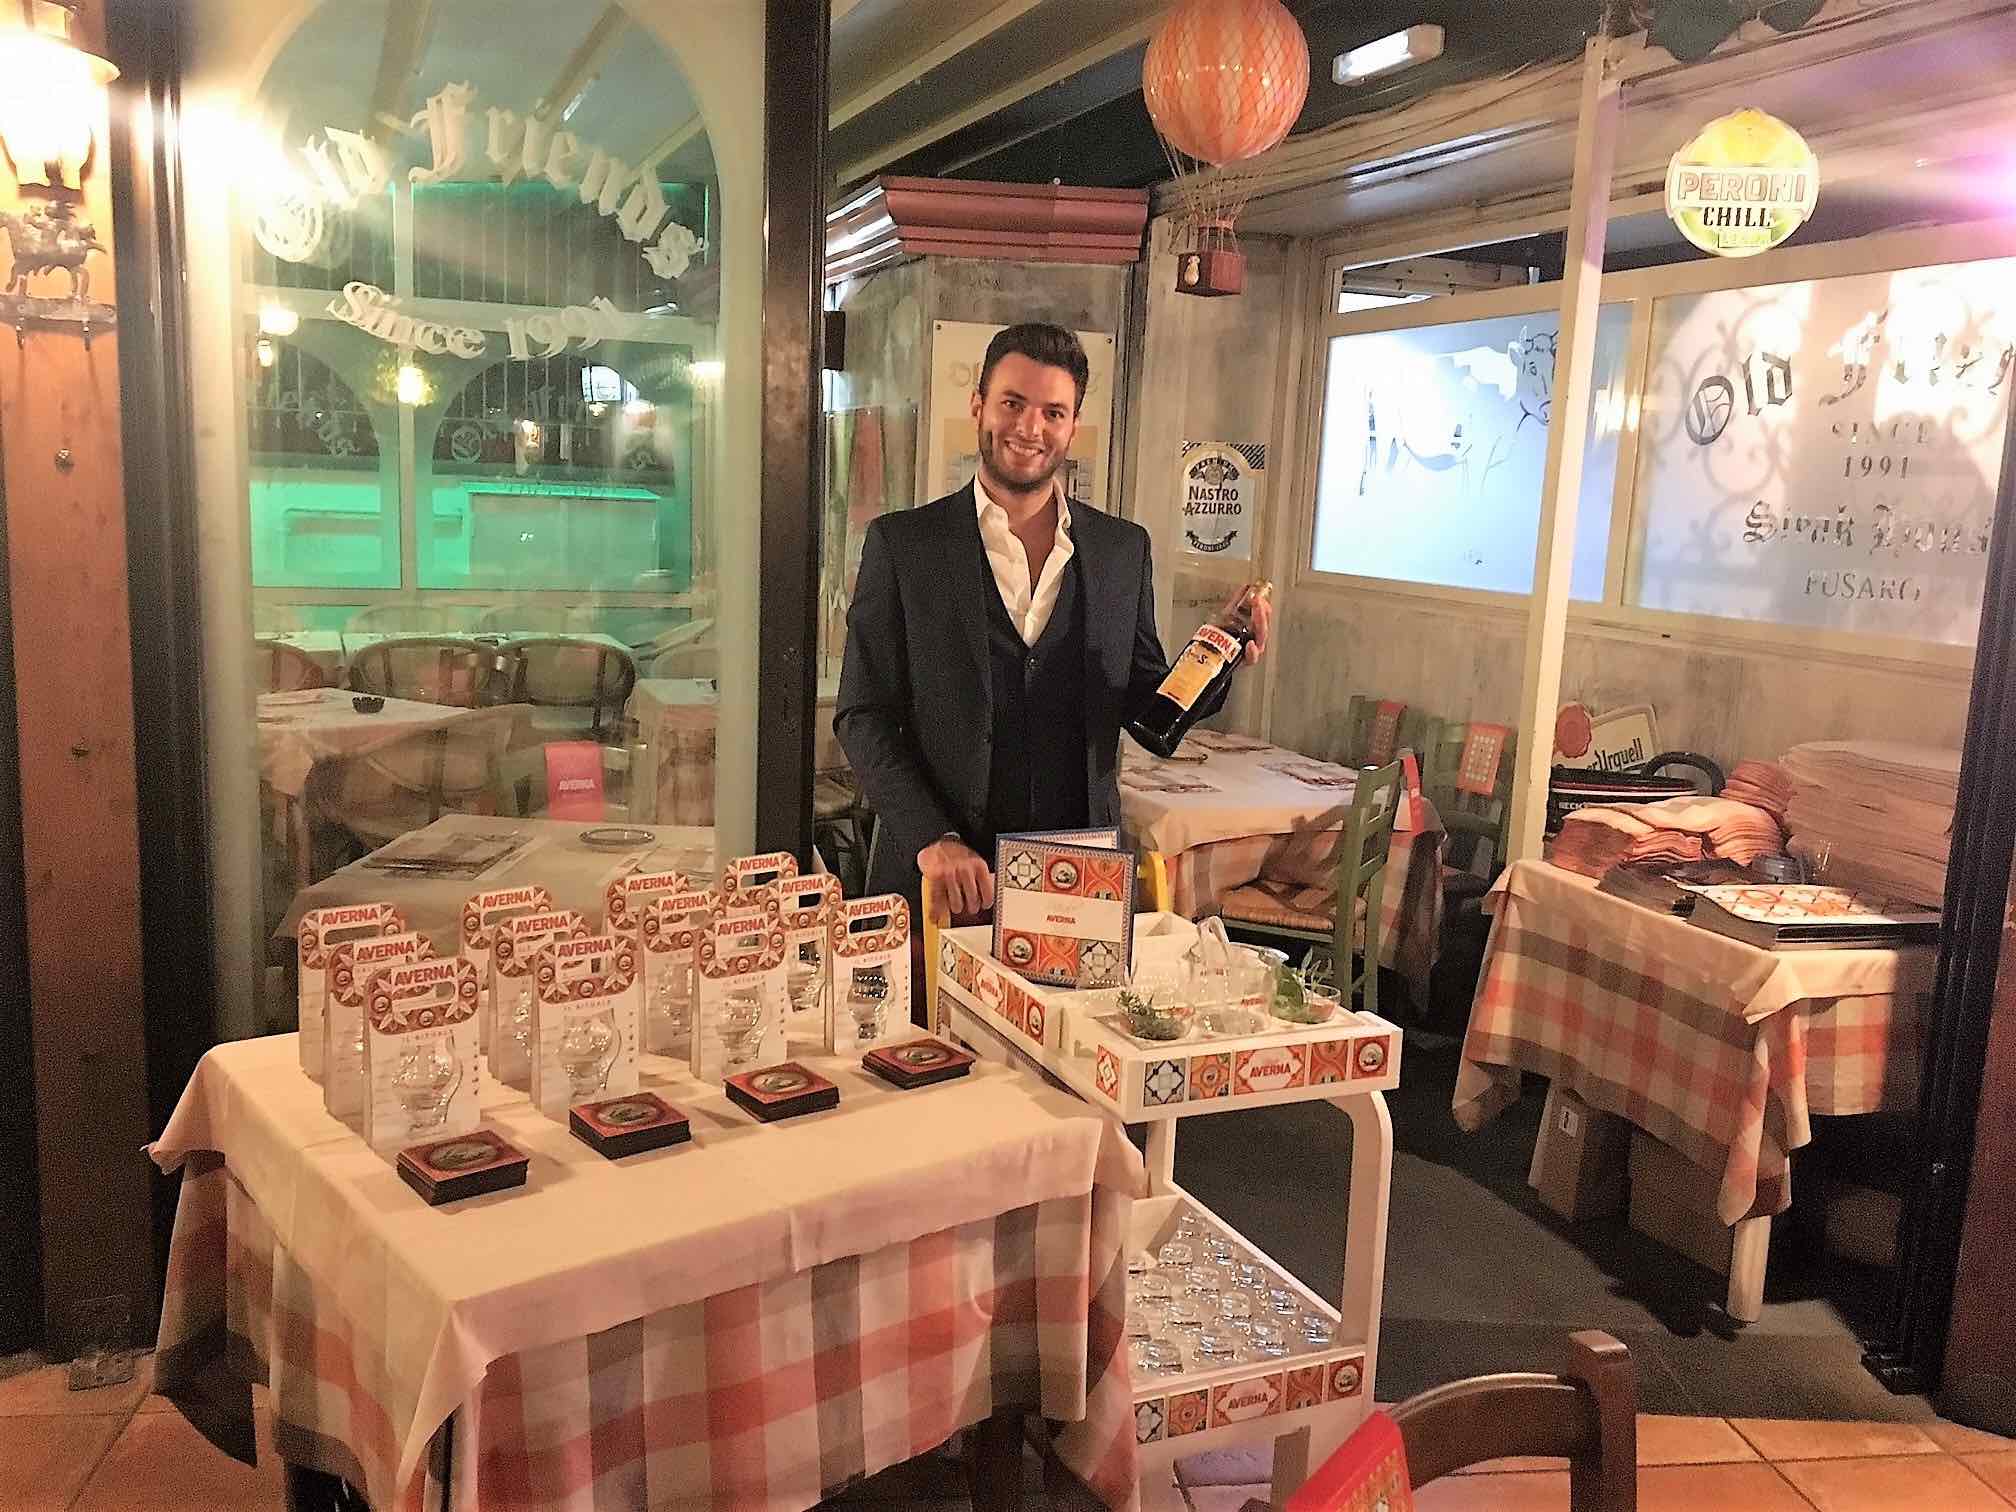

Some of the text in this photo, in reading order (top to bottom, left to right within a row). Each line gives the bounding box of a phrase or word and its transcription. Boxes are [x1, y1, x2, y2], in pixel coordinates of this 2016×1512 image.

[1678, 172, 1807, 202] PERONI
[1703, 206, 1771, 227] CHILL
[325, 281, 486, 359] Since
[1685, 351, 1793, 446] Old
[1844, 456, 1909, 479] 1991
[1183, 502, 1242, 515] AZZURRO
[739, 856, 779, 871] AVERNA
[628, 876, 674, 892] AVERNA
[781, 878, 824, 894] AVERNA
[483, 890, 532, 909] AVERNA
[661, 895, 707, 911] AVERNA
[849, 900, 892, 916] AVERNA
[321, 907, 379, 925] AVERNA
[515, 915, 569, 934] AVERNA
[717, 918, 765, 936] AVERNA
[356, 941, 415, 961] AVERNA
[558, 939, 612, 958] AVERNA
[395, 964, 455, 986] AVERNA
[1250, 1063, 1291, 1079] AVERNA
[1228, 1392, 1268, 1409] AVERNA
